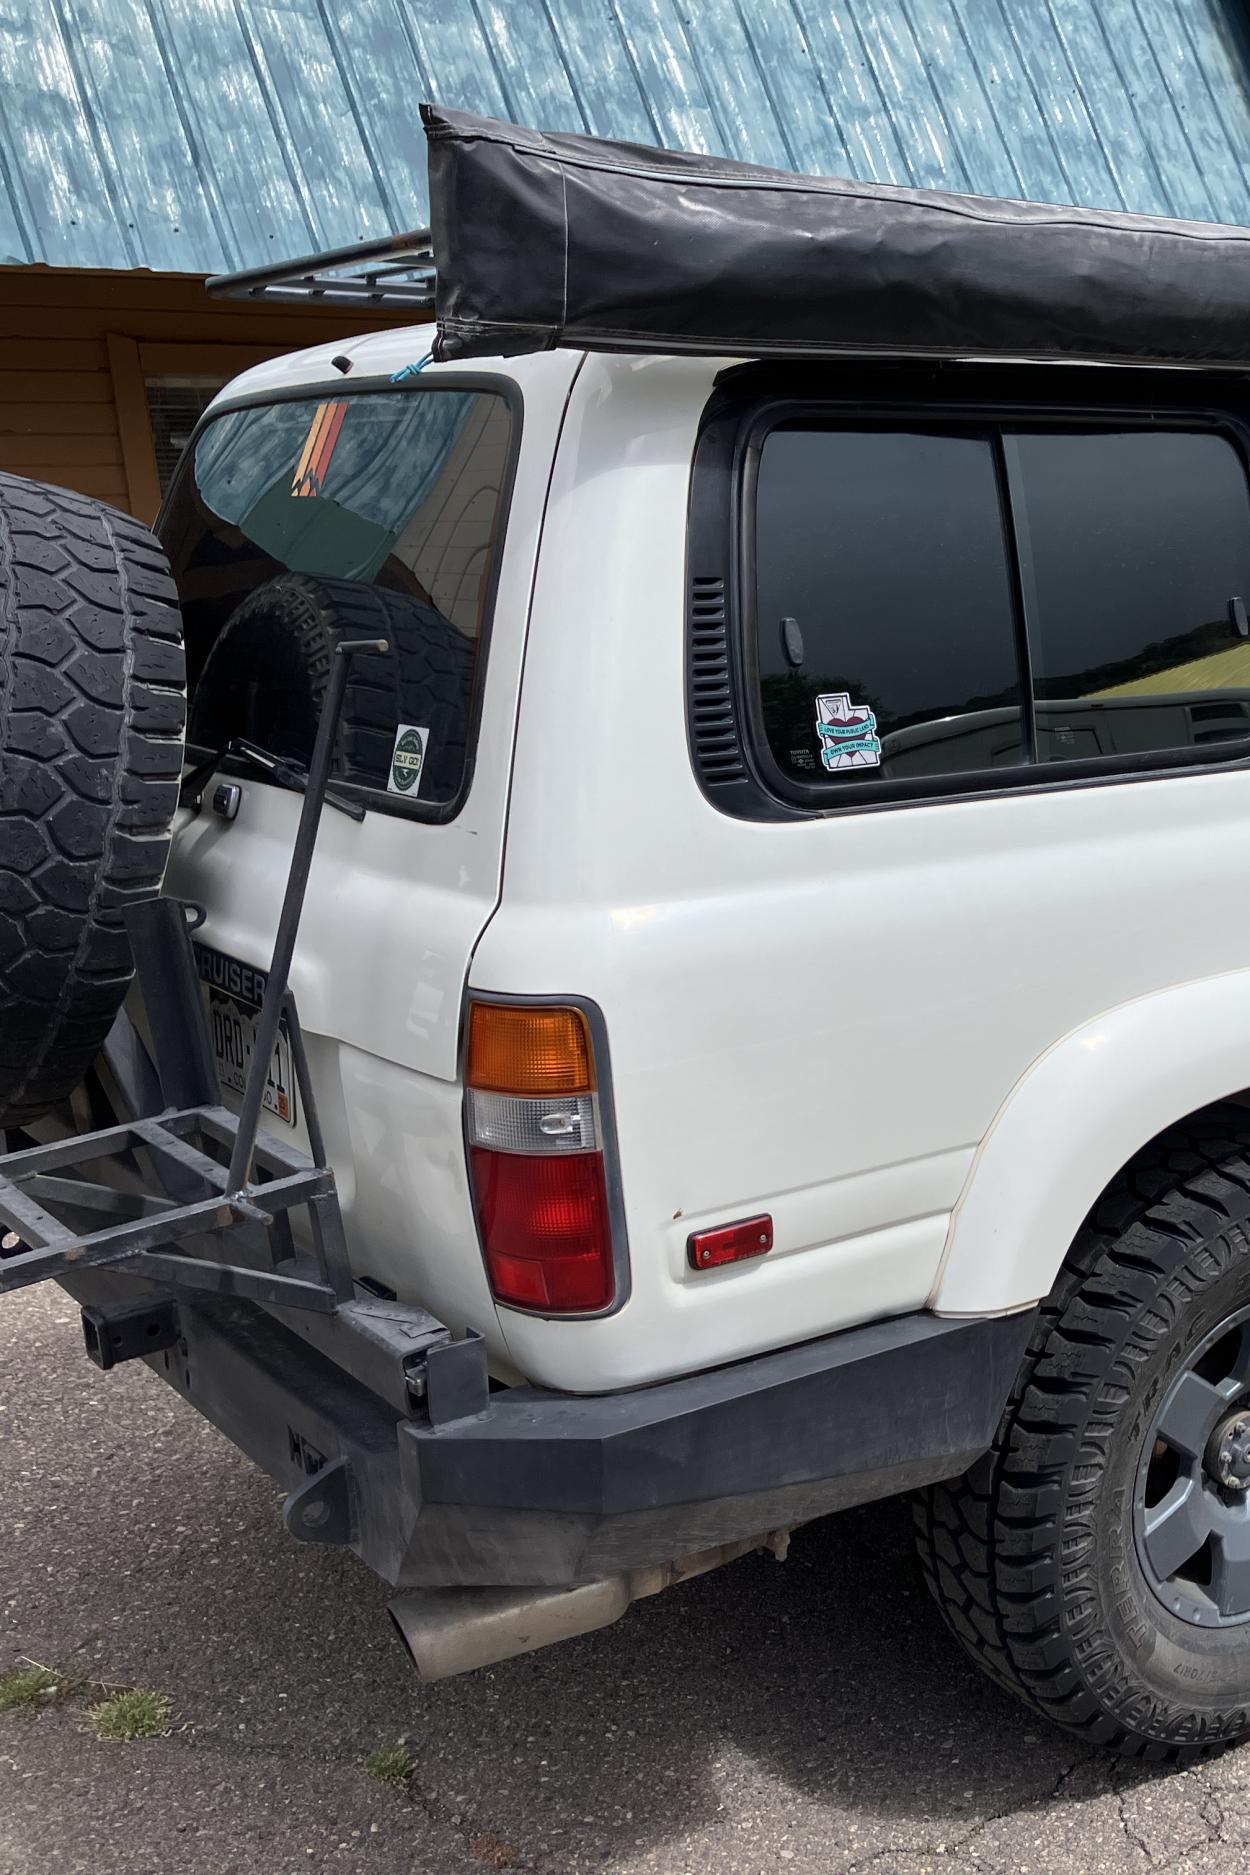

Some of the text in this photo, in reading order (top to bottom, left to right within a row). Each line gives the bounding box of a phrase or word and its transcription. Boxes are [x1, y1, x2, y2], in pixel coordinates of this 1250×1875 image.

[824, 726, 834, 734] LOVE
[842, 743, 855, 751] YOUR
[198, 951, 265, 1001] RUISER
